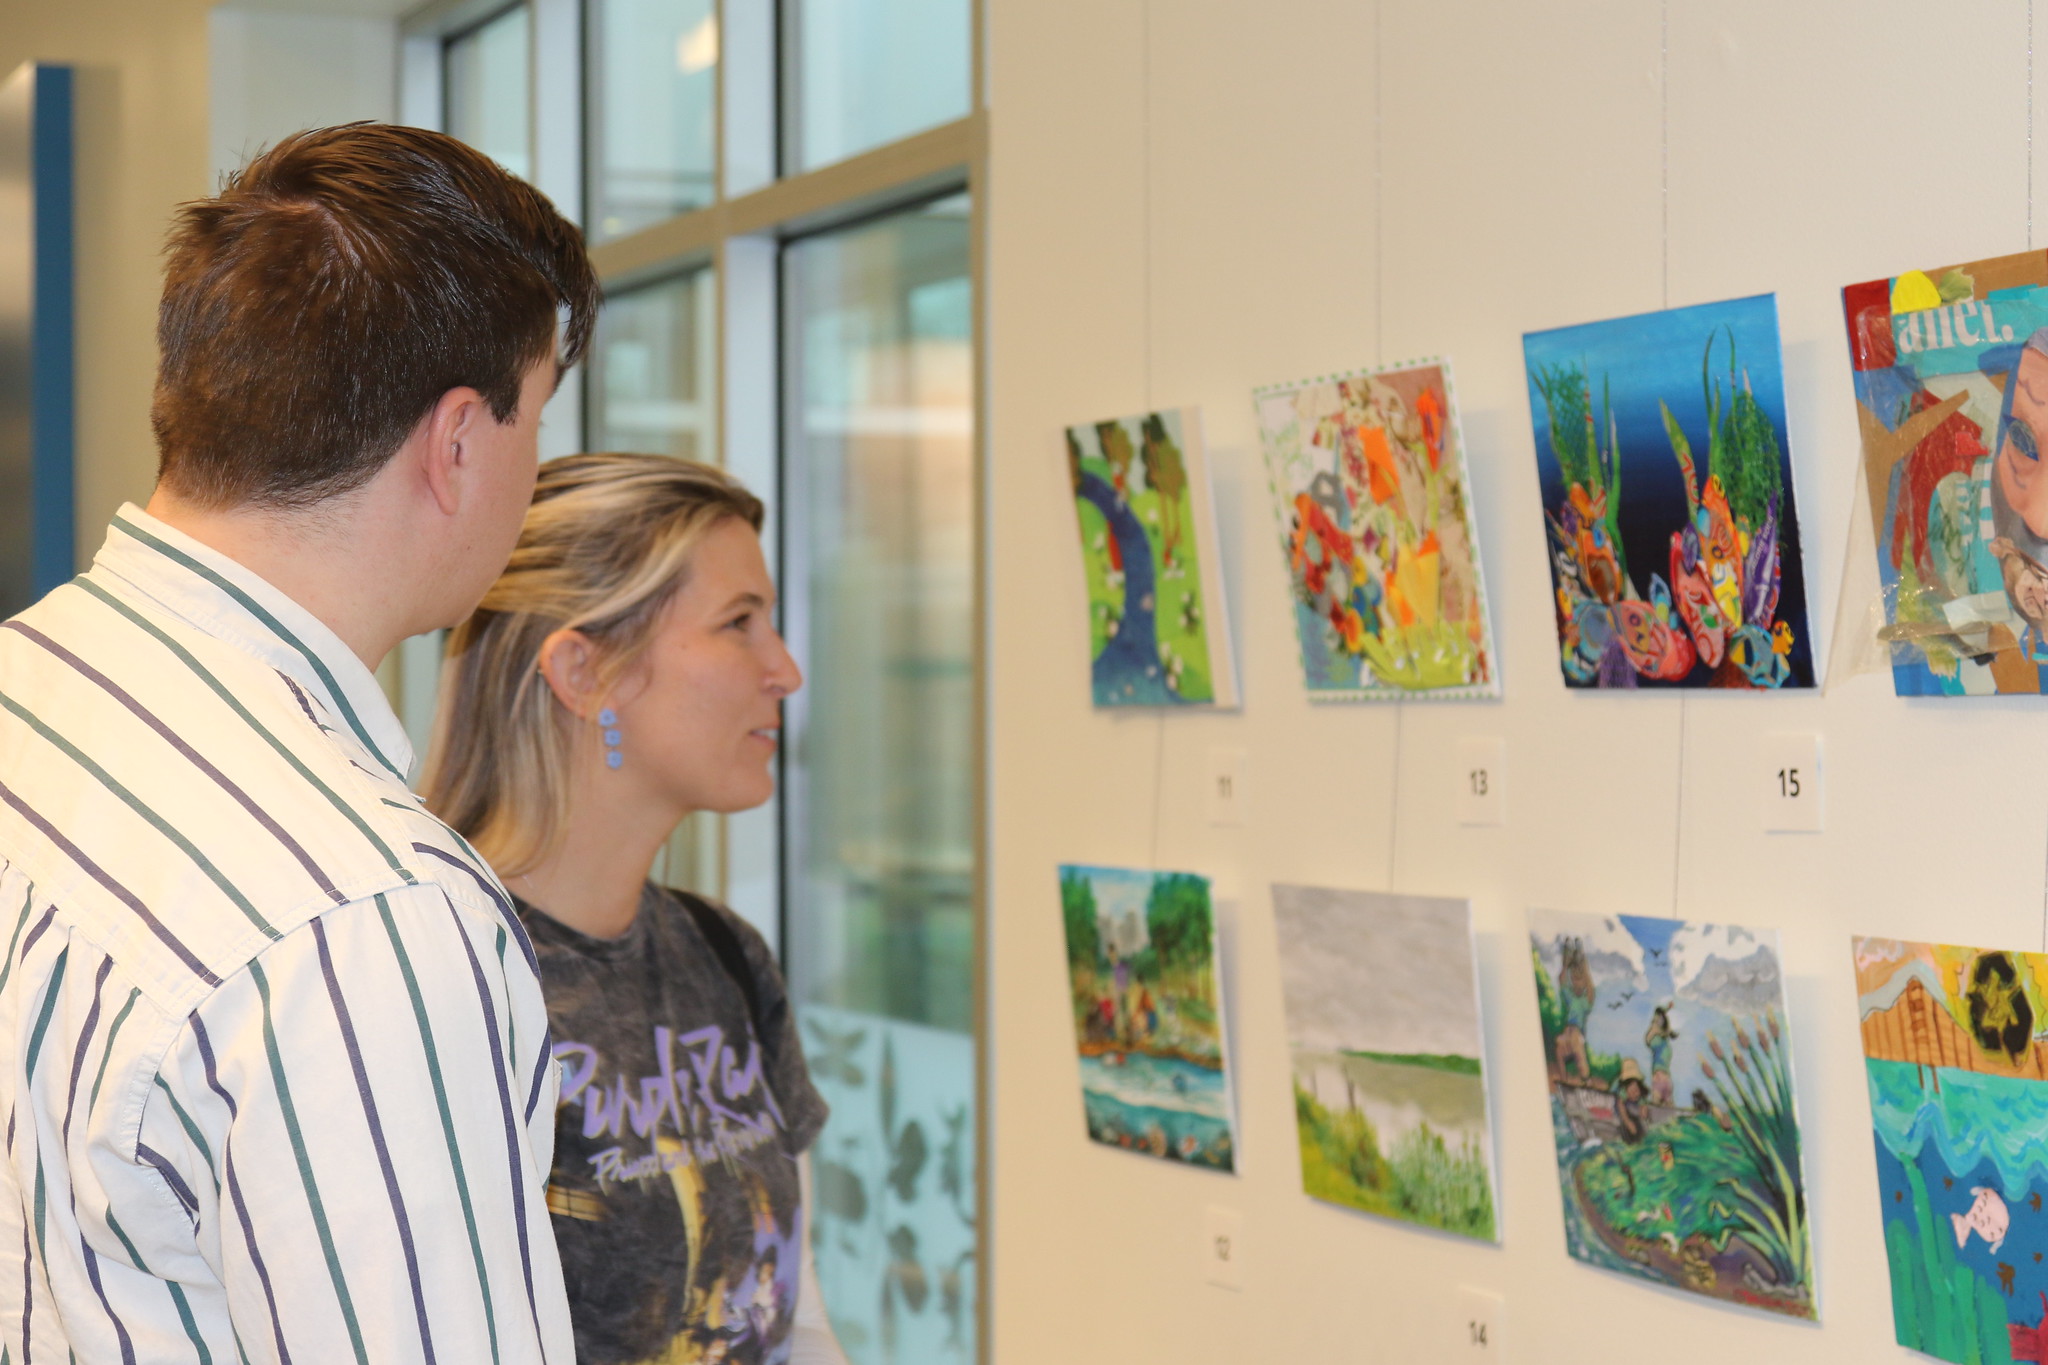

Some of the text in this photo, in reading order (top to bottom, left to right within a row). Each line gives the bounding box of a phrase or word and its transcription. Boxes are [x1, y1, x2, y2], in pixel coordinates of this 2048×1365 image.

[1470, 770, 1488, 796] 13
[1778, 769, 1800, 797] 15
[1469, 1320, 1488, 1349] 14
